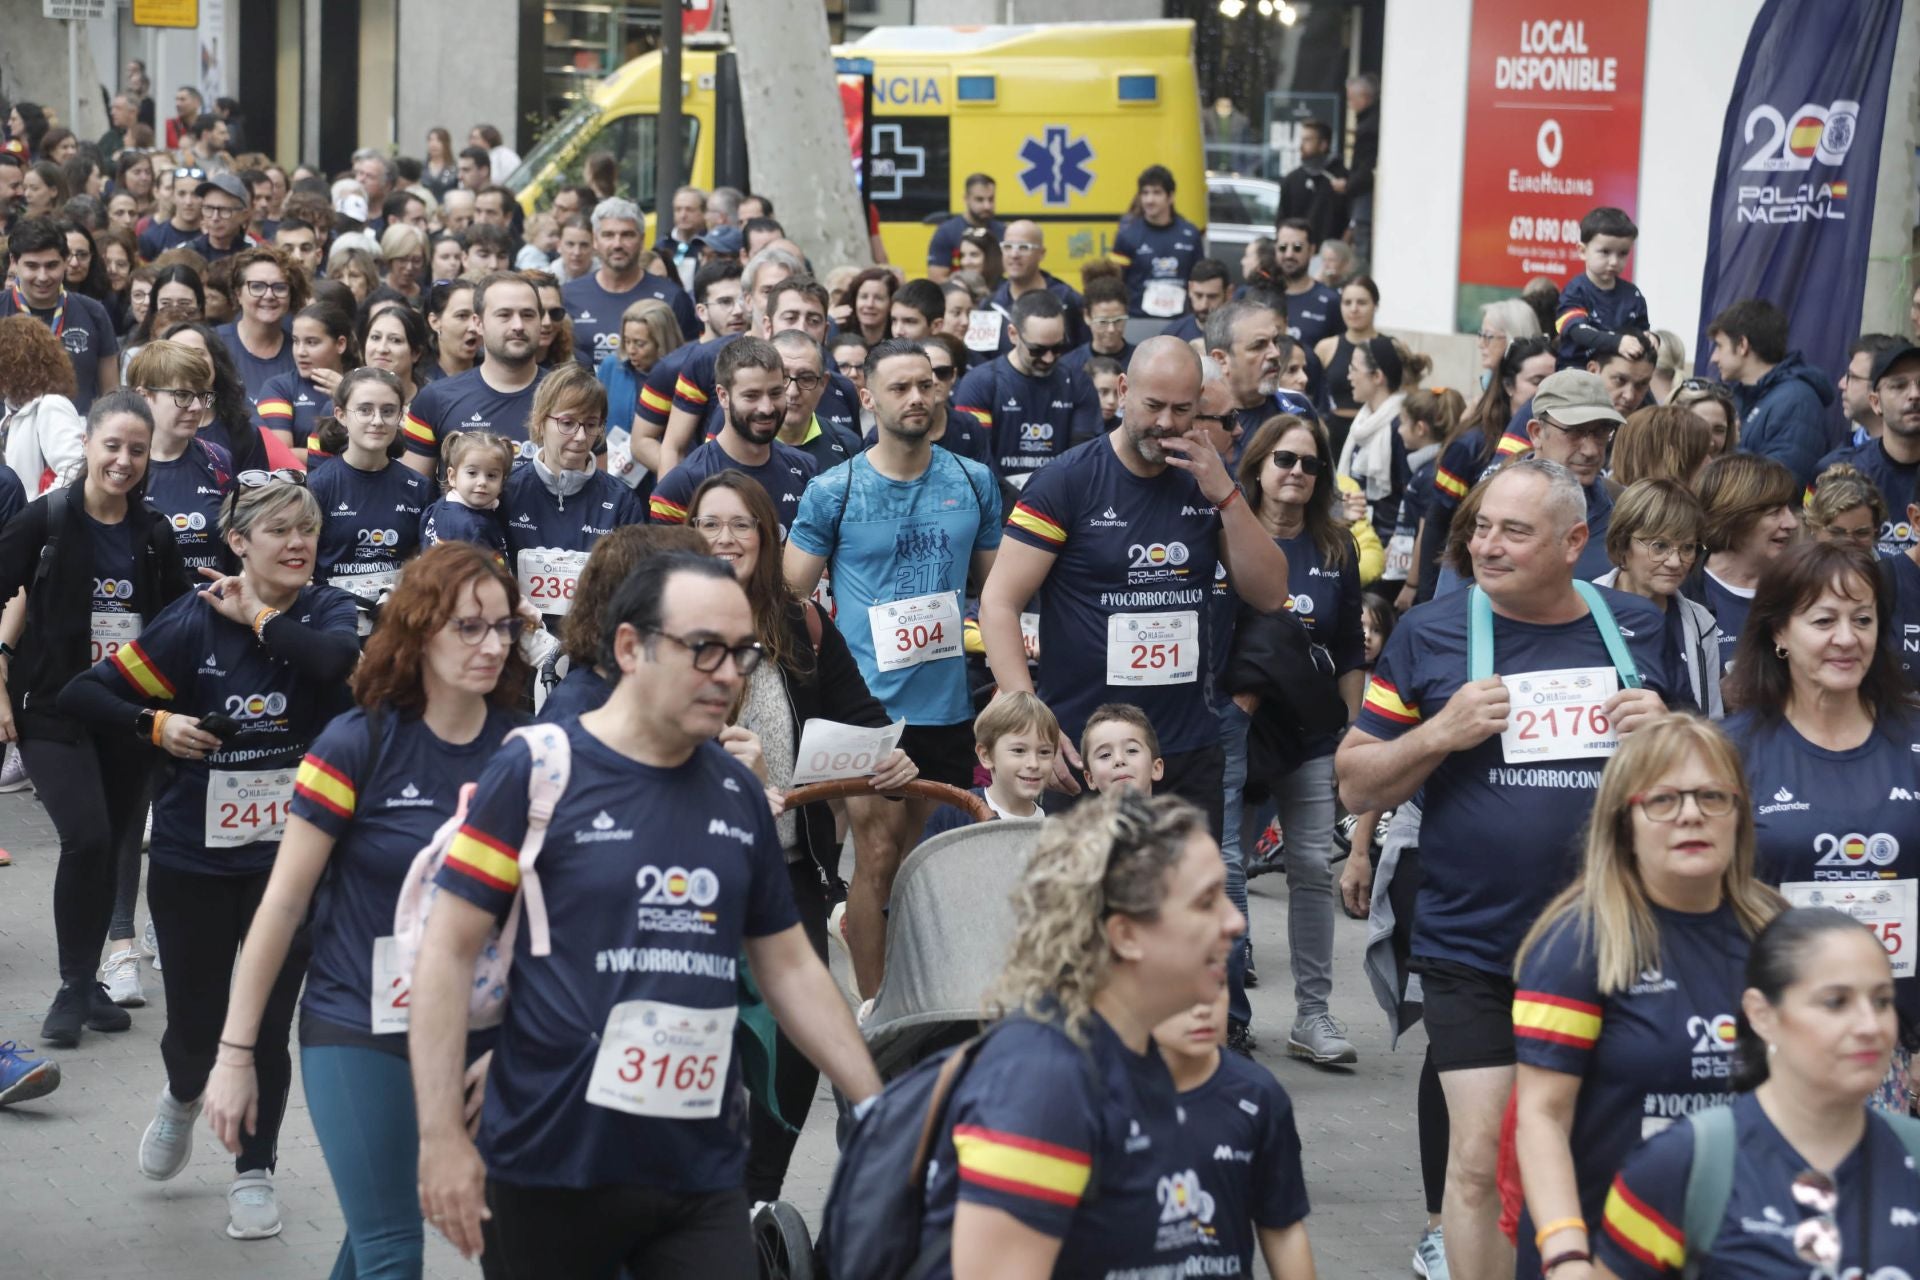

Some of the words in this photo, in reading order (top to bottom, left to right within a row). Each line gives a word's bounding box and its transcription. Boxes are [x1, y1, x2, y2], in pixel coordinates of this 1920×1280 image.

[1520, 20, 1589, 54] LOCAL
[1495, 57, 1618, 91] DISPONIBLE
[1742, 101, 1860, 171] 200
[1020, 423, 1053, 440] 200
[164, 512, 206, 532] 00
[509, 520, 538, 531] Santander
[1090, 518, 1128, 527] Santander
[357, 529, 399, 546] 200
[1128, 542, 1190, 569] 200
[895, 561, 955, 595] 21K
[1128, 569, 1176, 578] POLICIA
[93, 577, 133, 599] 200
[895, 621, 944, 652] 304
[1131, 643, 1179, 669] 251
[225, 692, 287, 719] 200
[1516, 704, 1610, 740] 2176
[386, 797, 434, 807] Santander
[1759, 801, 1811, 815] Santander
[575, 829, 635, 843] Santander
[1813, 832, 1899, 865] 200
[1814, 869, 1880, 880] POLICIA
[636, 865, 719, 907] 200
[638, 907, 702, 920] POLICIA
[638, 919, 716, 934] NACIONAL
[618, 1047, 719, 1090] 3165
